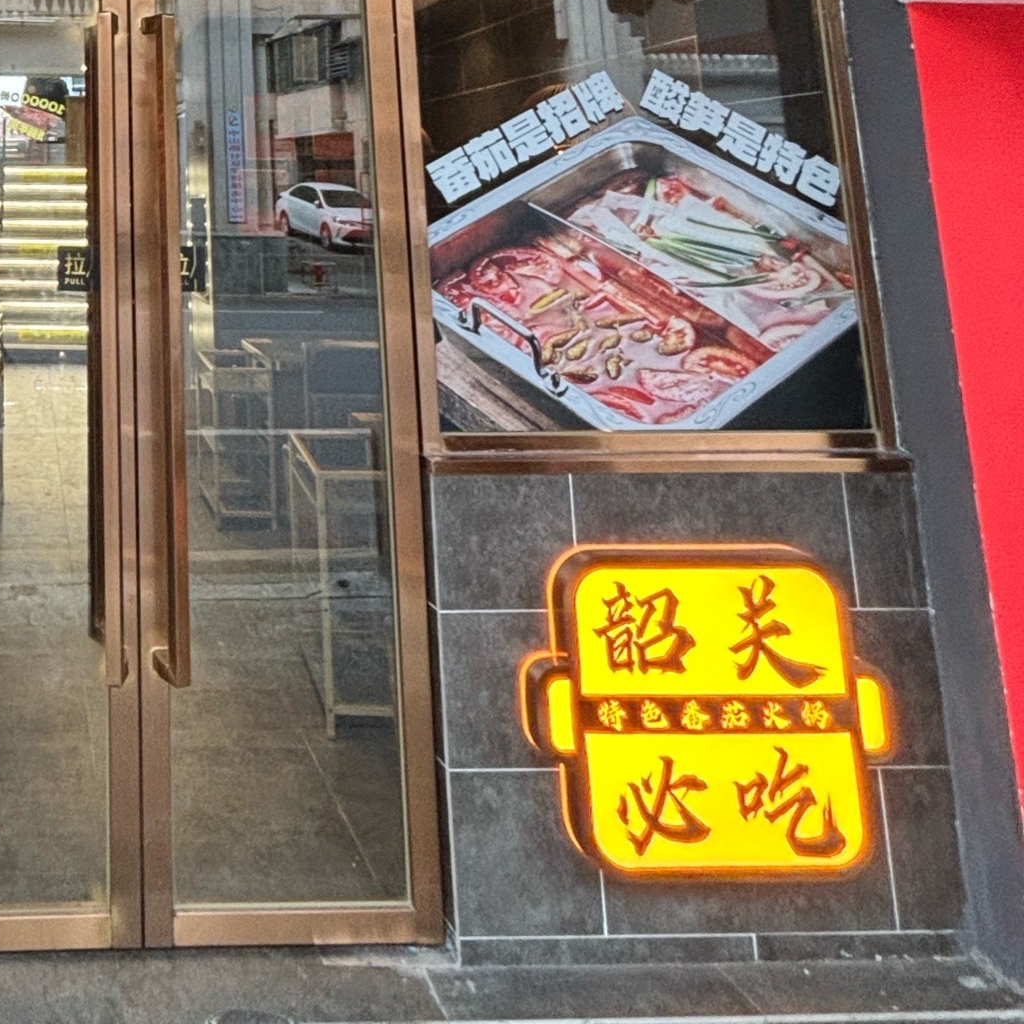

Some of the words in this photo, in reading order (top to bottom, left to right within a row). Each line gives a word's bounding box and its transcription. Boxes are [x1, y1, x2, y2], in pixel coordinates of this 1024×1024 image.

[426, 70, 625, 204] 番茄是招牌
[639, 68, 841, 207] 酸笋是特色
[64, 277, 86, 286] PULL
[65, 252, 87, 276] 拉
[593, 575, 829, 689] 韶关
[597, 699, 832, 731] 特色番茄火锅
[617, 746, 847, 858] 必吃
